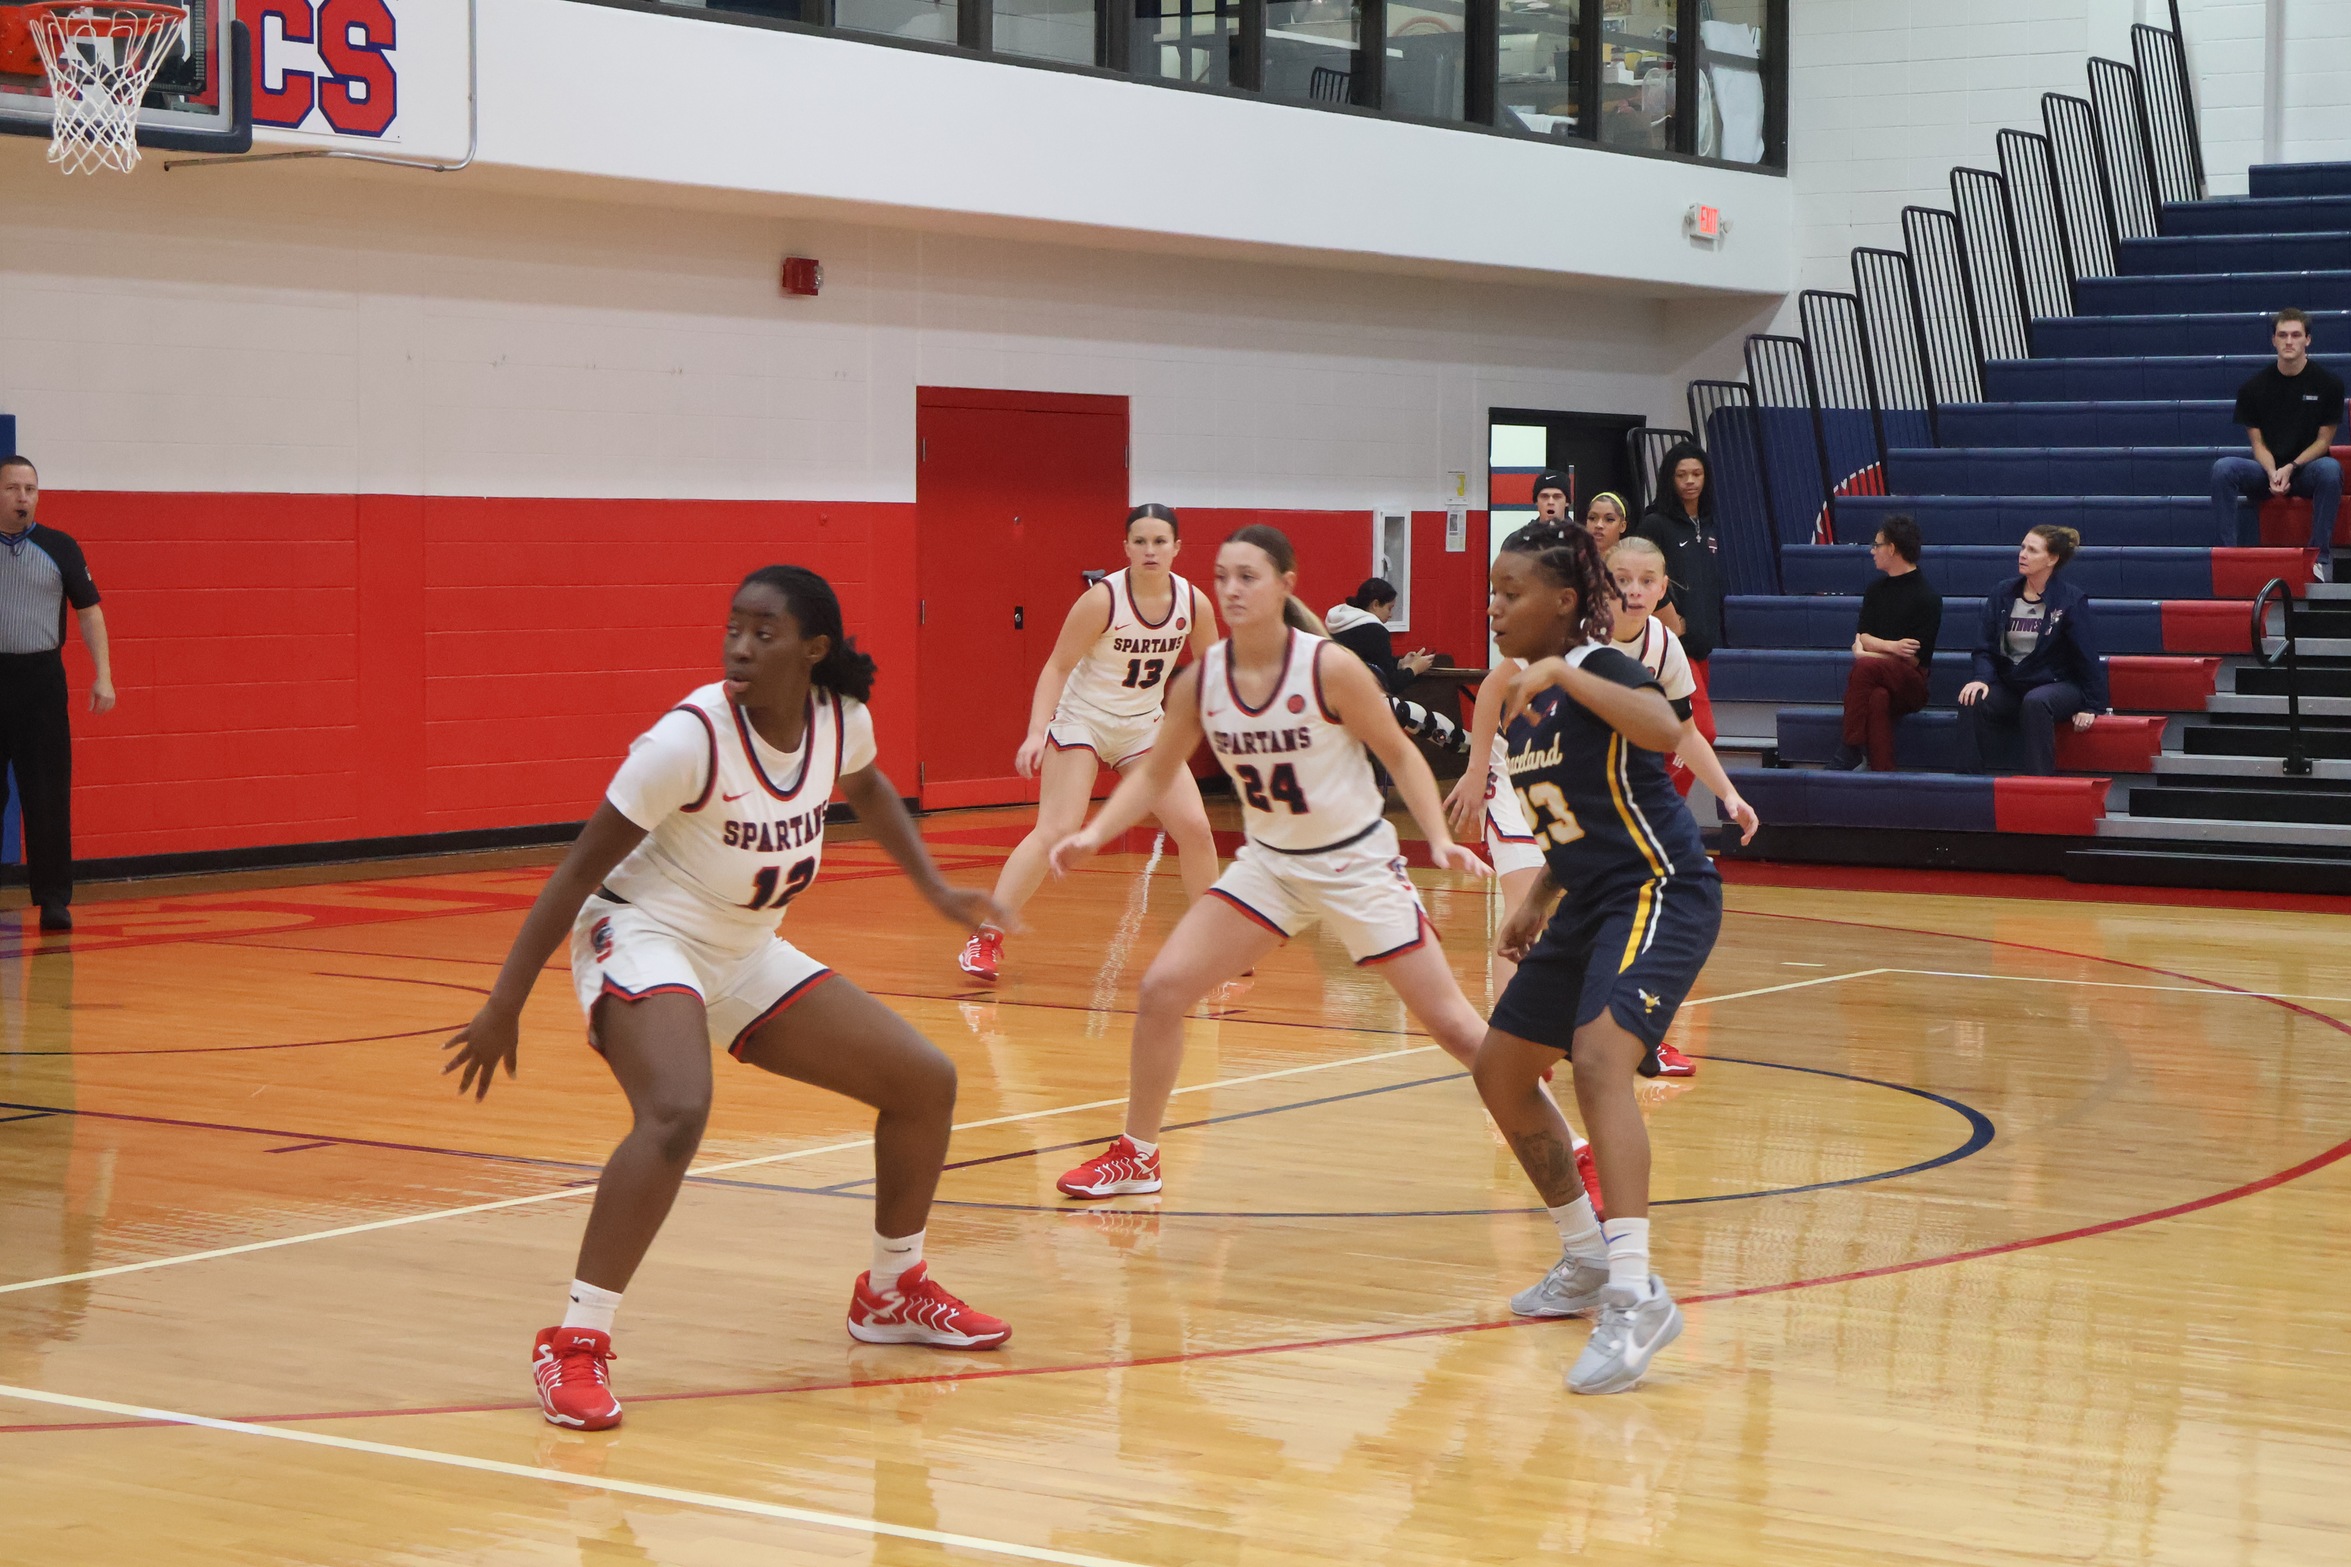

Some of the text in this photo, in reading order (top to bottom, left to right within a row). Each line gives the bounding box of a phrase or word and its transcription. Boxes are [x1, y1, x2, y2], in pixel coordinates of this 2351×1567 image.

[1699, 205, 1719, 235] EXIT
[1113, 635, 1184, 653] SPARTANS
[1121, 658, 1165, 690] 13
[1234, 762, 1311, 816] 24
[738, 855, 816, 911] 12
